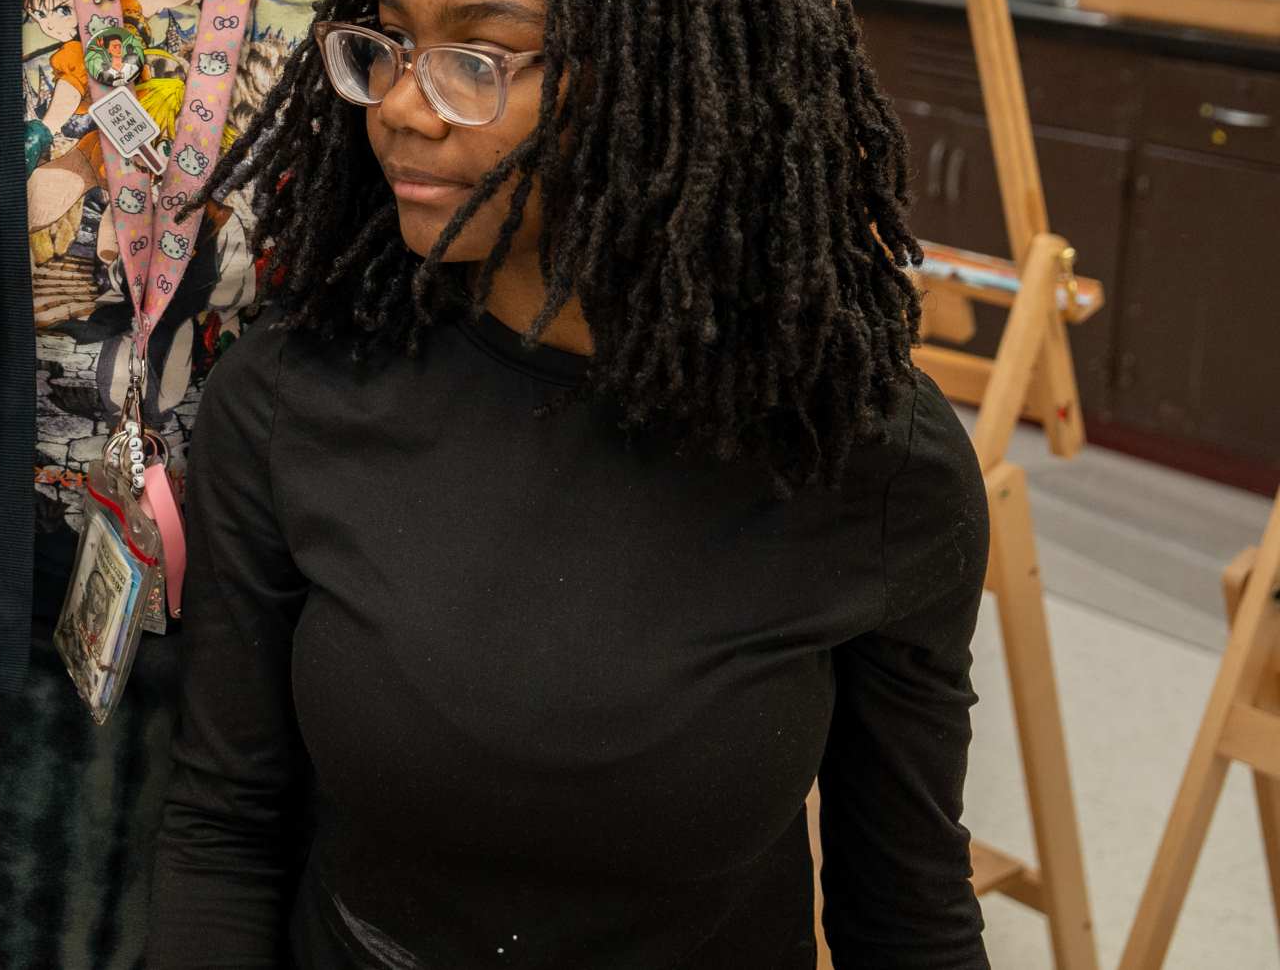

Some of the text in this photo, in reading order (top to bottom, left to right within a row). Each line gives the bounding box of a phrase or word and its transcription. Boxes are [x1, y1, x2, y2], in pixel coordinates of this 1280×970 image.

[108, 104, 122, 116] GOD
[111, 113, 126, 126] HAS
[118, 117, 137, 134] PLAN
[120, 121, 147, 145] FOR YOU
